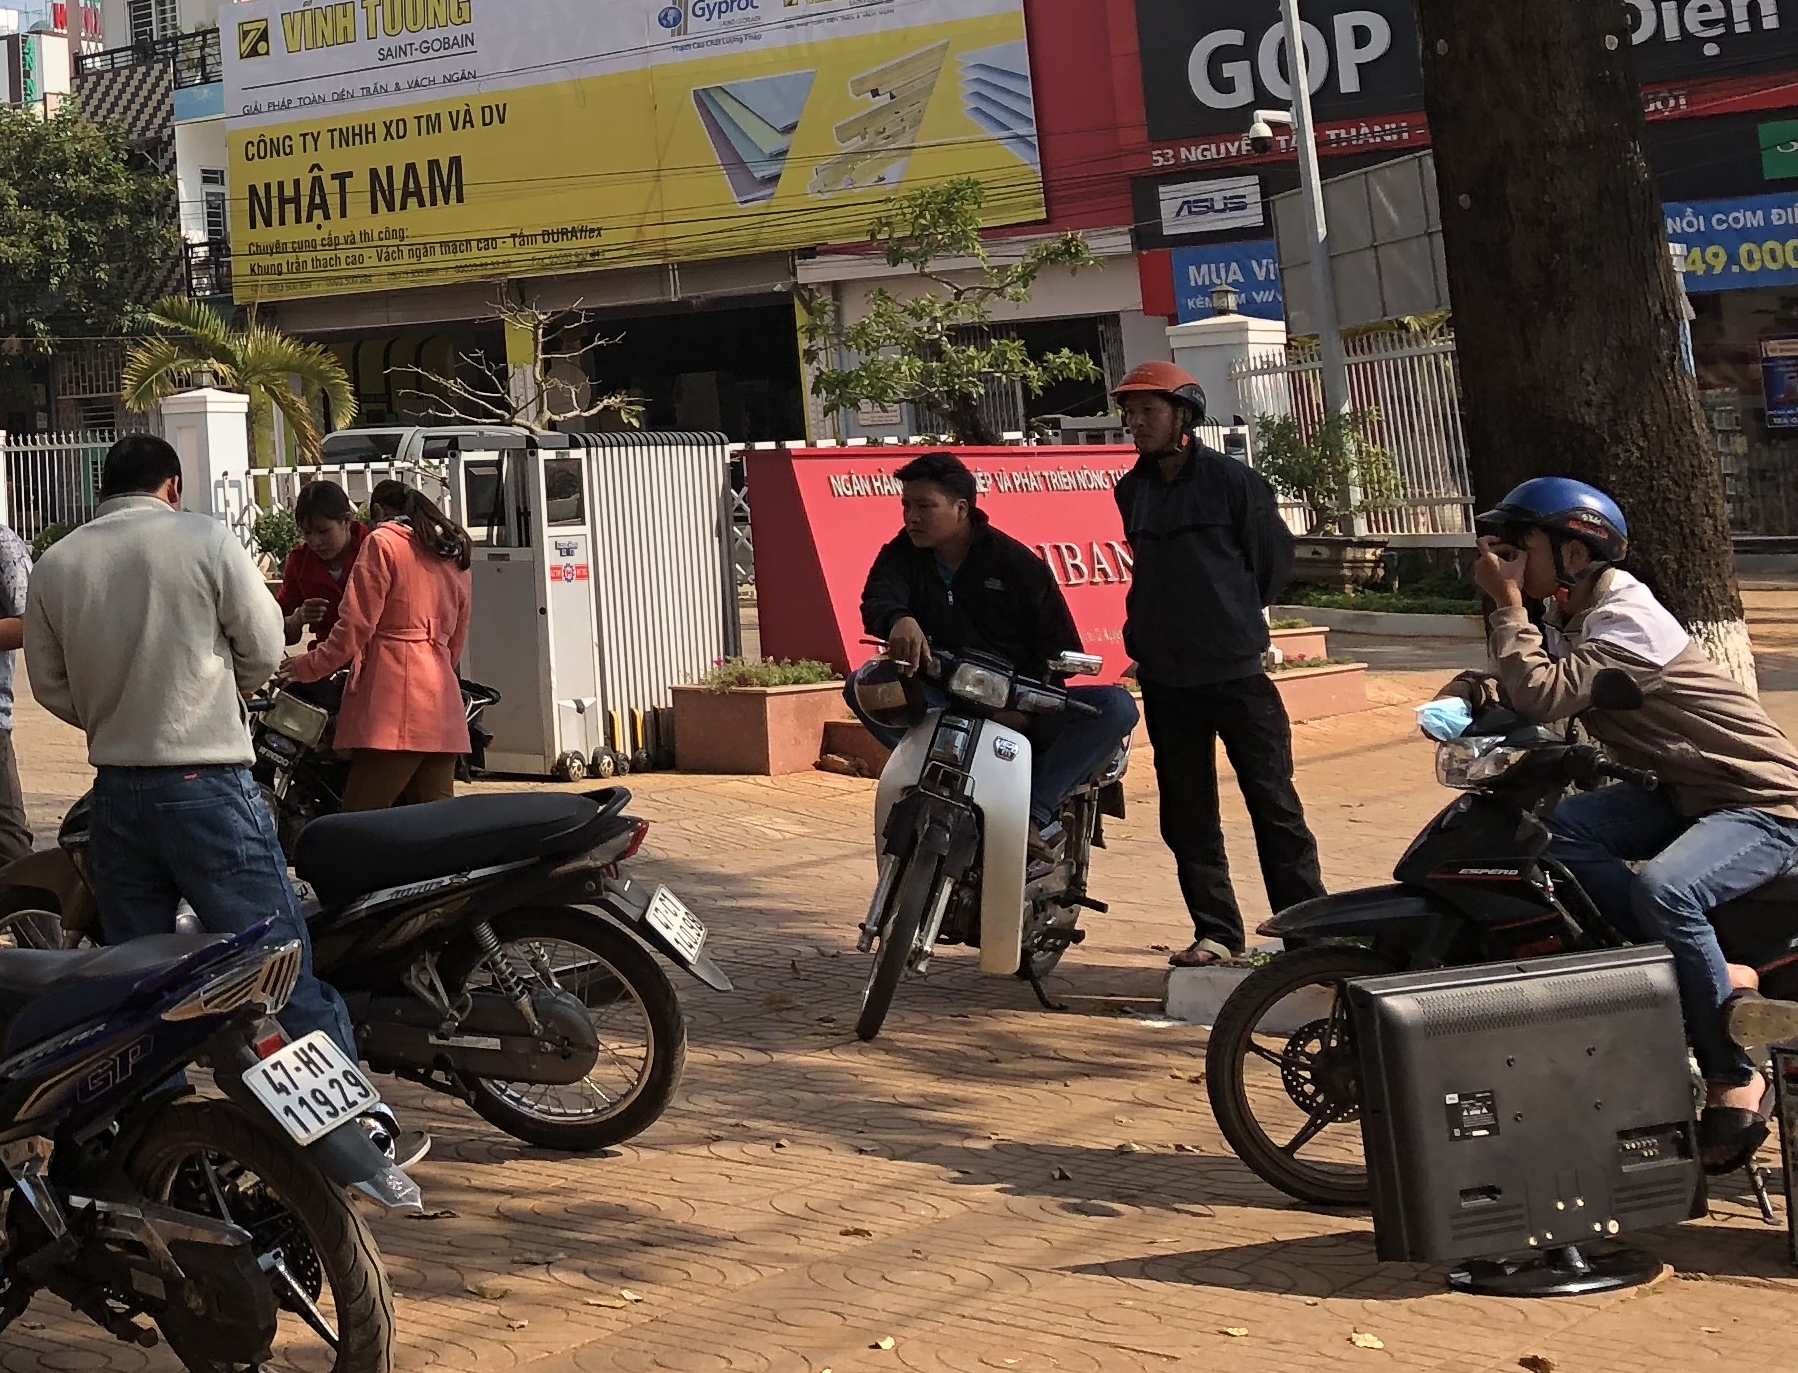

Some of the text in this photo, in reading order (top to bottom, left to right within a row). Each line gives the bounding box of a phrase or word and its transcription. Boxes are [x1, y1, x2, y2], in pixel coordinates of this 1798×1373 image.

[281, 0, 356, 53] VĨNH
[377, 33, 475, 62] SAINT-GOBAIN
[297, 91, 326, 106] TOÀN
[407, 75, 436, 90] VÁCH
[244, 103, 508, 161] CÔNG TY TNHH XD TM VÀ DV
[1326, 122, 1409, 147] THÀNH
[1152, 149, 1175, 167] 53
[1180, 132, 1253, 164] NGUYỄ
[248, 155, 465, 231] NHẬT NAM
[1175, 194, 1248, 218] ASUS
[1666, 207, 1705, 235] NỒI
[1711, 208, 1764, 231] CƠM
[248, 226, 410, 257] Chuyên cung cấp và thi công:
[249, 262, 283, 276] Khung
[286, 254, 308, 271] trần
[345, 253, 365, 266] cao
[376, 247, 404, 263] Vách
[476, 238, 498, 252] cao
[1188, 261, 1245, 287] MUA
[828, 468, 871, 497] NGÂN
[873, 467, 903, 496] HÀN
[996, 466, 1013, 494] VÀ
[1013, 464, 1045, 493] PHÁT
[1045, 464, 1077, 492] TRIỂN
[1076, 464, 1110, 492] NÔNG
[282, 1069, 371, 1134] 119.29
